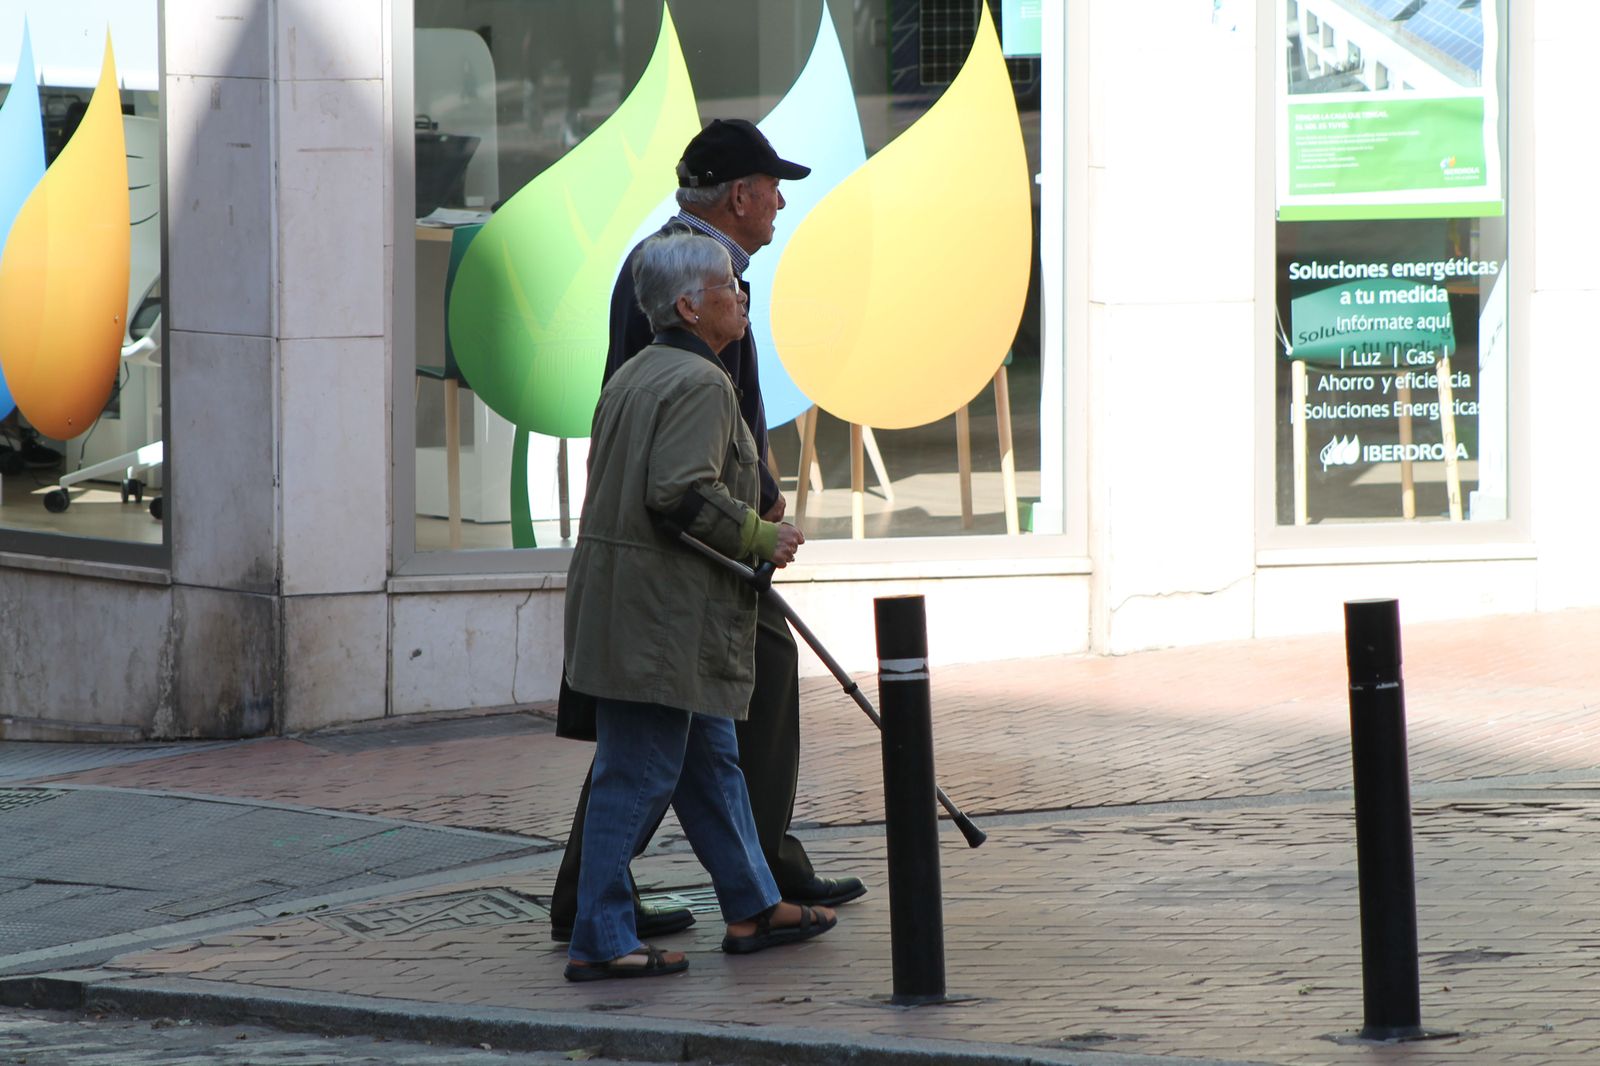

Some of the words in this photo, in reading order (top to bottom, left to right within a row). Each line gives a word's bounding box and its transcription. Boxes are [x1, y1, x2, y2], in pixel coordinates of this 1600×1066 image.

[1289, 260, 1389, 280] Soluciones
[1392, 257, 1499, 281] energéticas
[1340, 291, 1351, 305] a
[1355, 288, 1375, 305] tu
[1379, 284, 1448, 304] medida
[1336, 315, 1413, 331] Infórmate
[1417, 313, 1451, 331] aquí
[1353, 350, 1381, 366] Luz
[1406, 348, 1435, 365] Gas
[1318, 373, 1374, 391] Ahorro
[1381, 376, 1392, 394] y
[1395, 371, 1471, 389] eficiecia
[1363, 443, 1469, 461] IBERDROA
